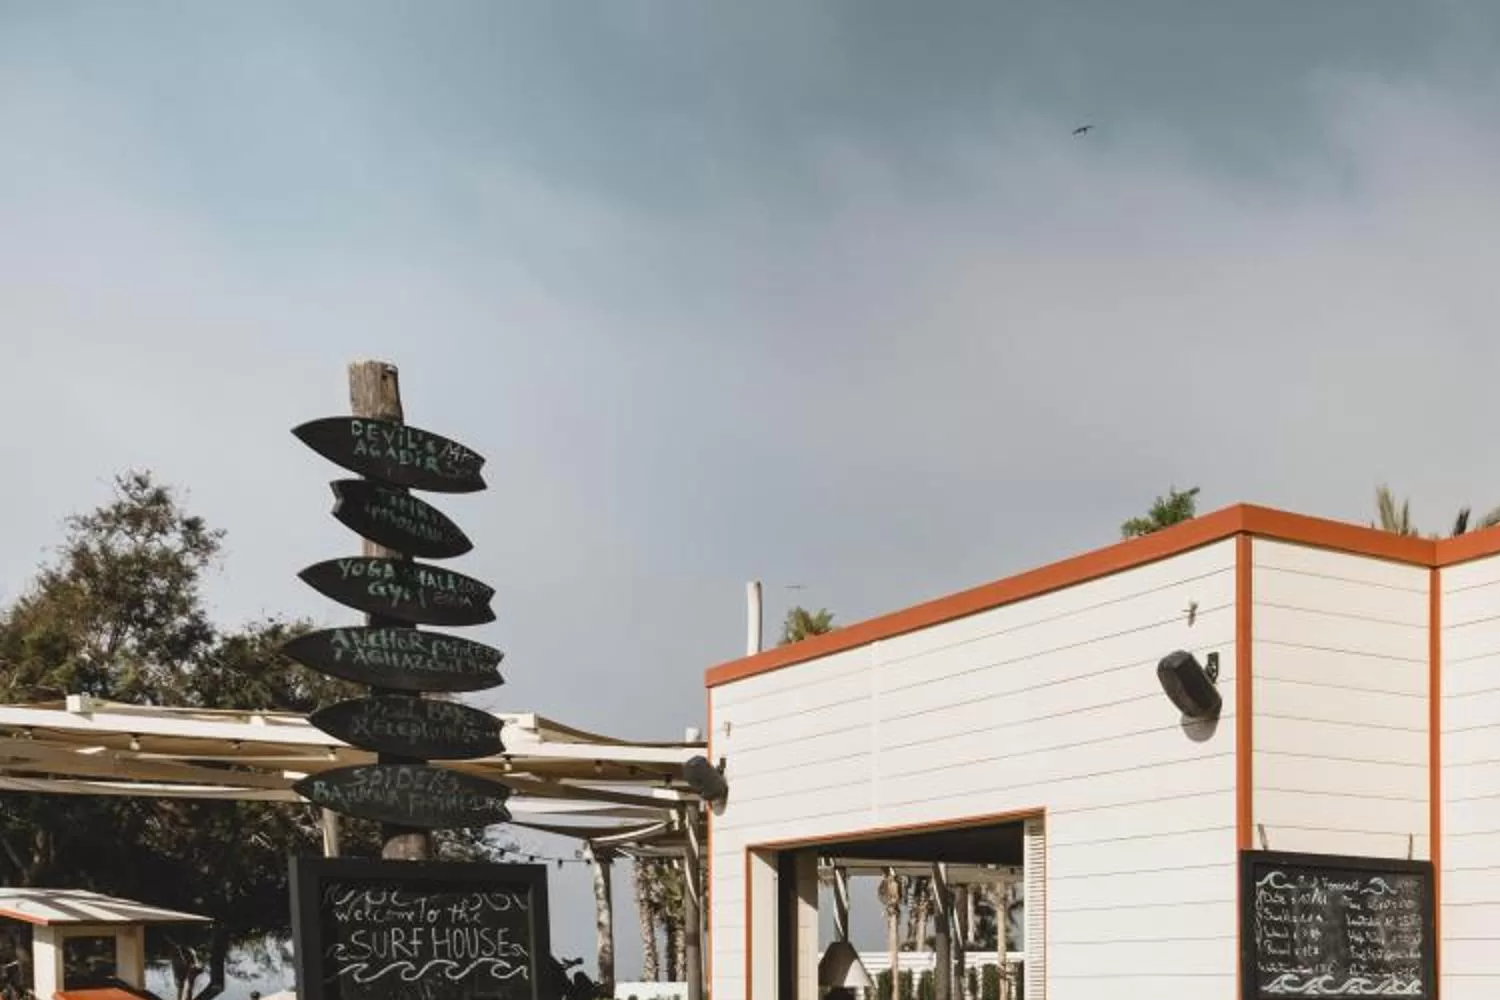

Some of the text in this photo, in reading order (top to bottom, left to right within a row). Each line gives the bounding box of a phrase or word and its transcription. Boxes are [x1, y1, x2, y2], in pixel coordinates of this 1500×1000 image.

[338, 559, 395, 580] YOGA
[351, 926, 511, 960] SURF HOUSE
